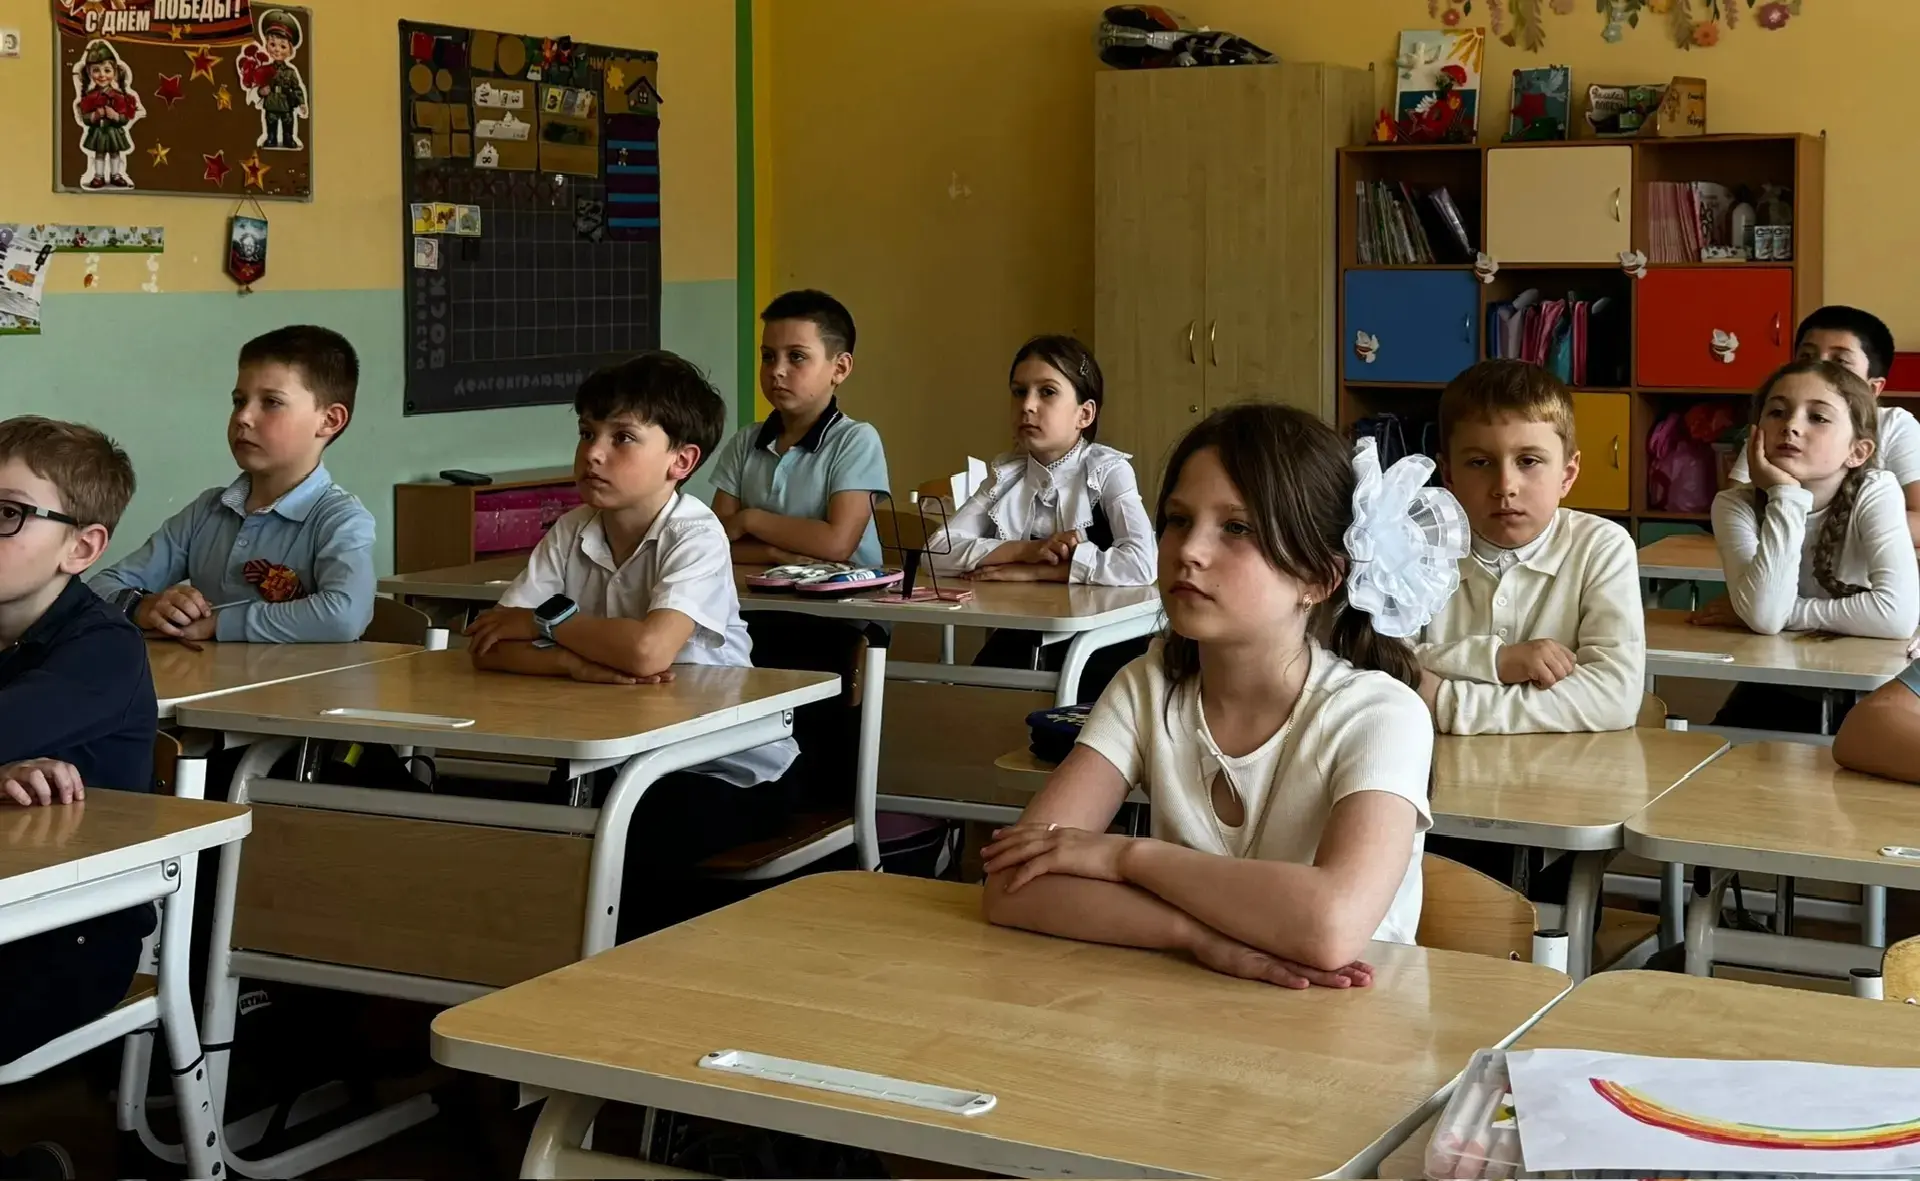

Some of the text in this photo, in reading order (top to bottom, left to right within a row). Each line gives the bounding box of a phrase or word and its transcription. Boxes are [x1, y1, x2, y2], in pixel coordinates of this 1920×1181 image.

[86, 0, 241, 35] С ДНЁМ ПОБЕДЫ!
